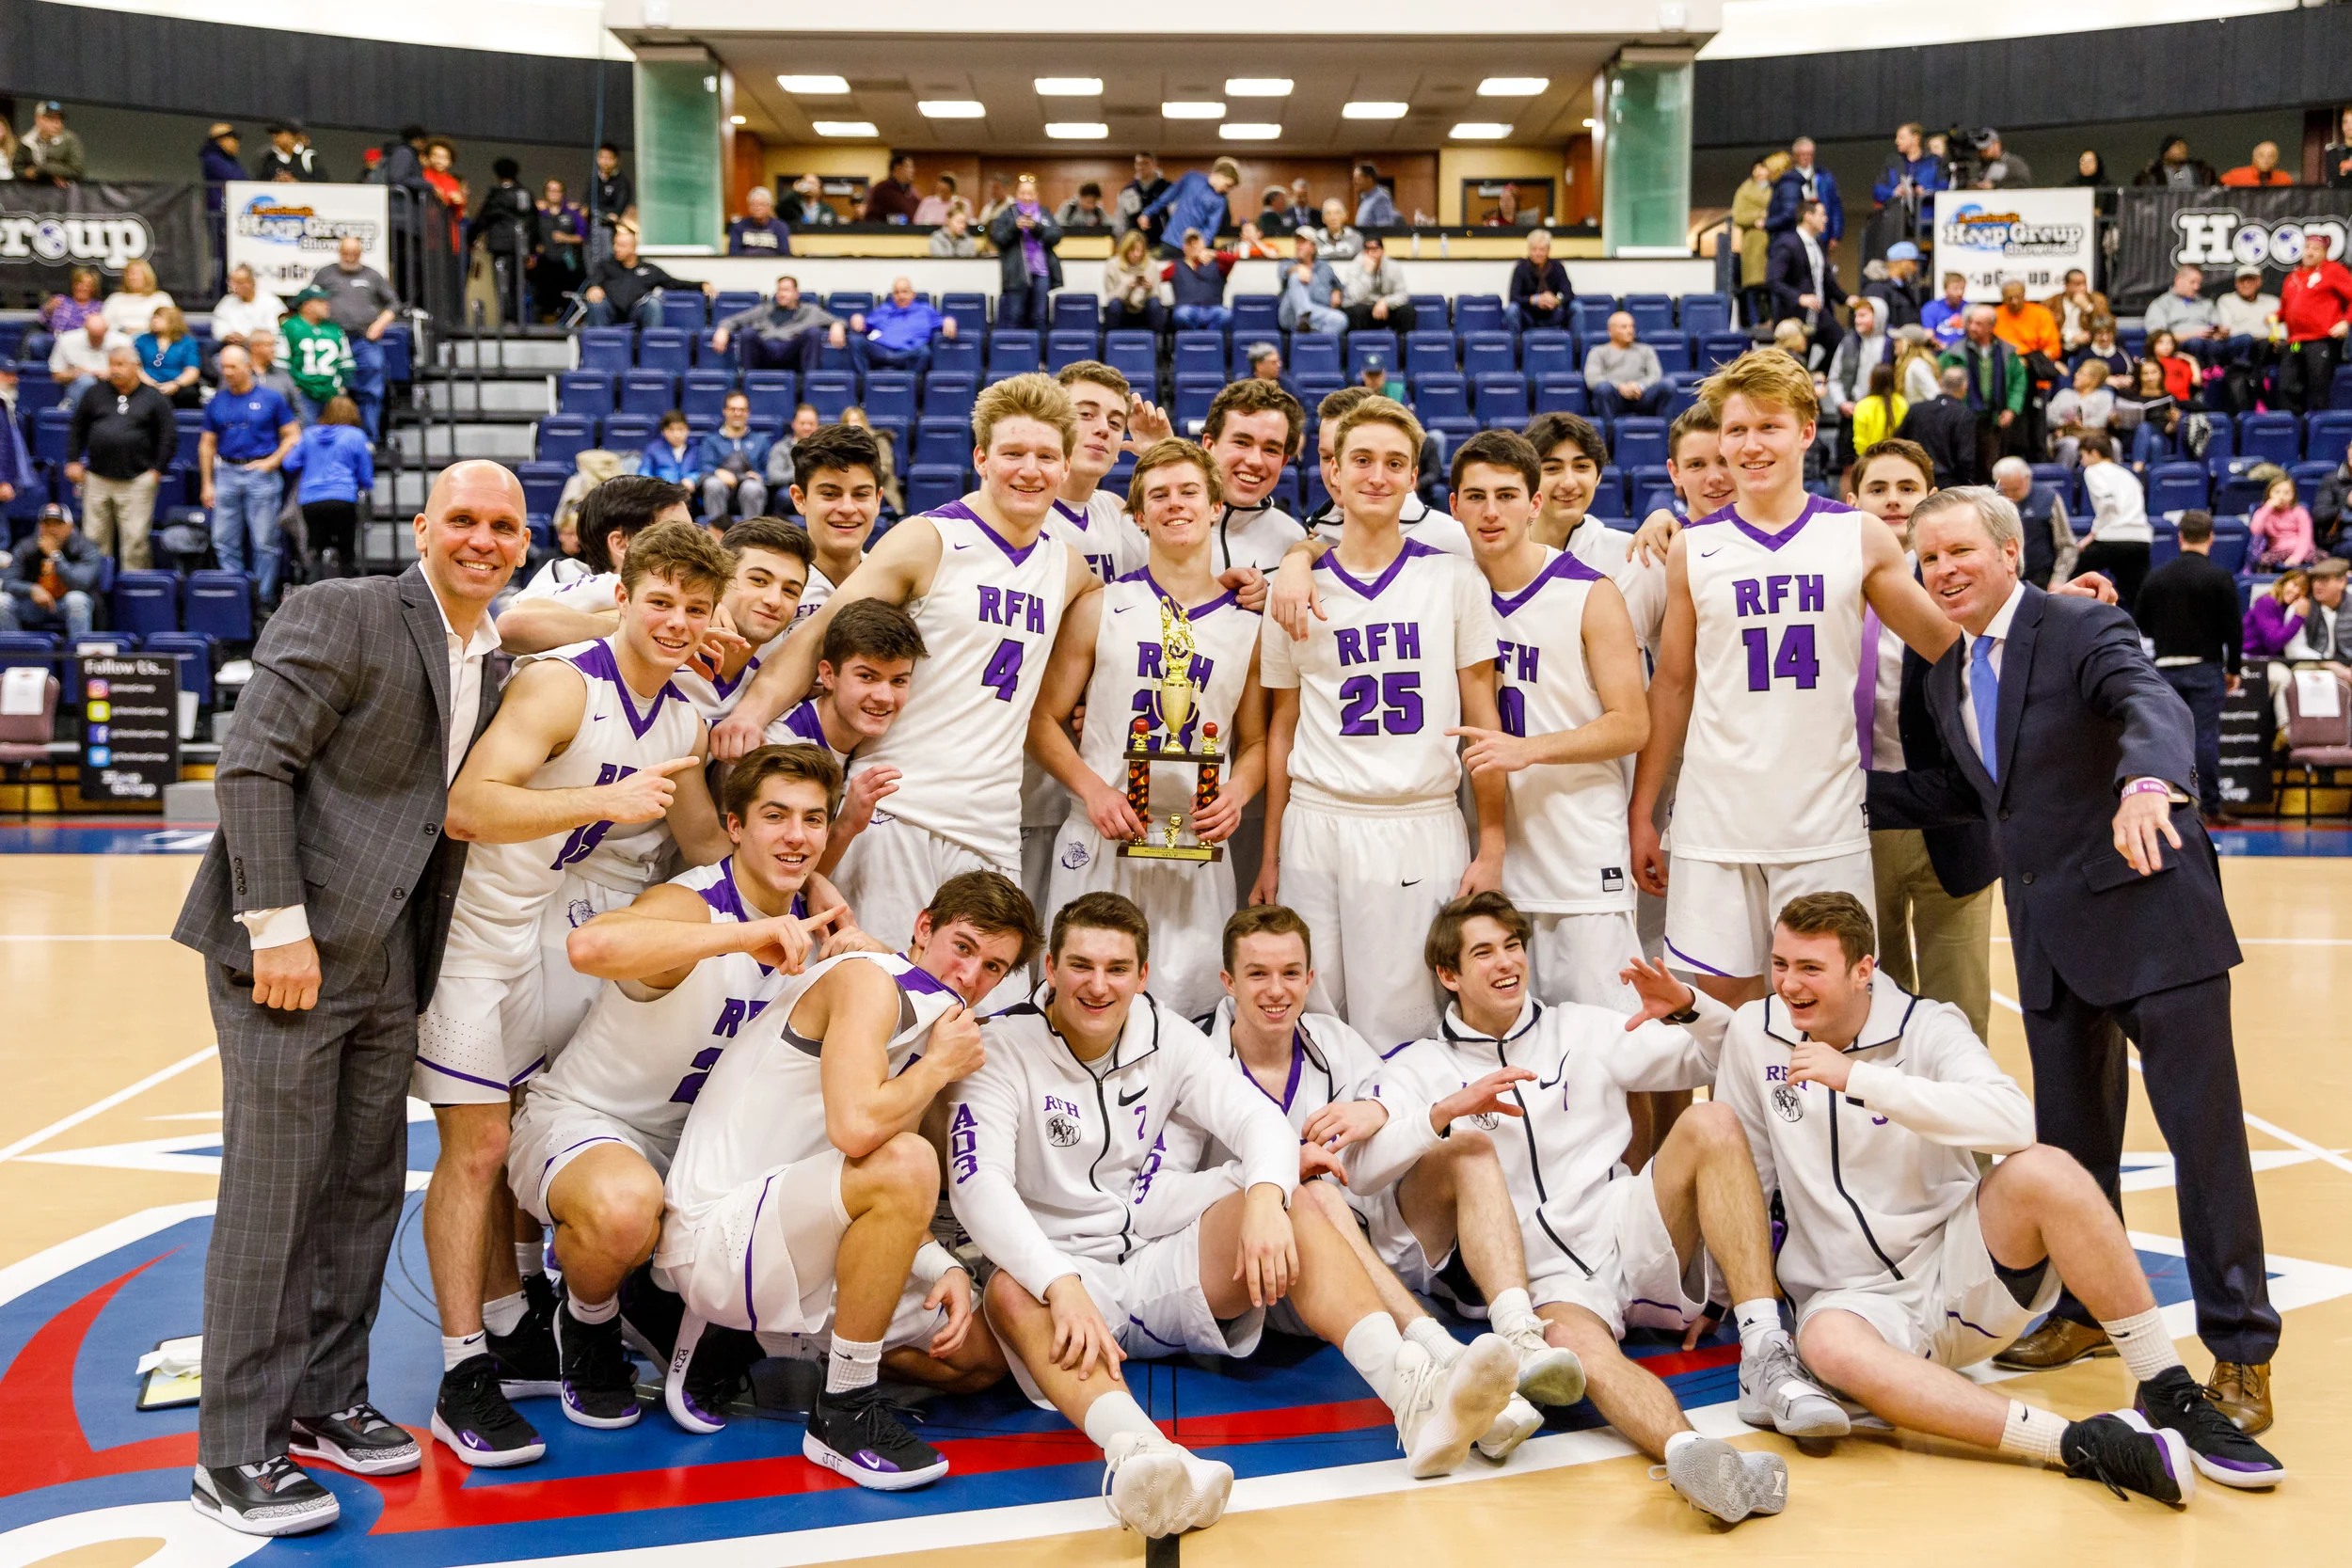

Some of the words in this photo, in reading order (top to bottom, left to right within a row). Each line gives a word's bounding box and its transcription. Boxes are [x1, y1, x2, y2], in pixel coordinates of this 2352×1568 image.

[0, 218, 148, 269] roup
[1944, 222, 2008, 245] Hoop
[2009, 221, 2084, 244] Group
[2177, 214, 2345, 264] Hoop
[298, 338, 340, 376] 12
[977, 584, 1045, 635] RFH
[1730, 575, 1825, 618] RFH
[1136, 641, 1215, 694] RH
[1333, 621, 1422, 667] RFH
[1741, 624, 1820, 692] 14
[980, 638, 1025, 703] 4
[1339, 671, 1424, 736] 25
[1044, 1095, 1081, 1119] RFH
[1134, 1104, 1147, 1141] 7
